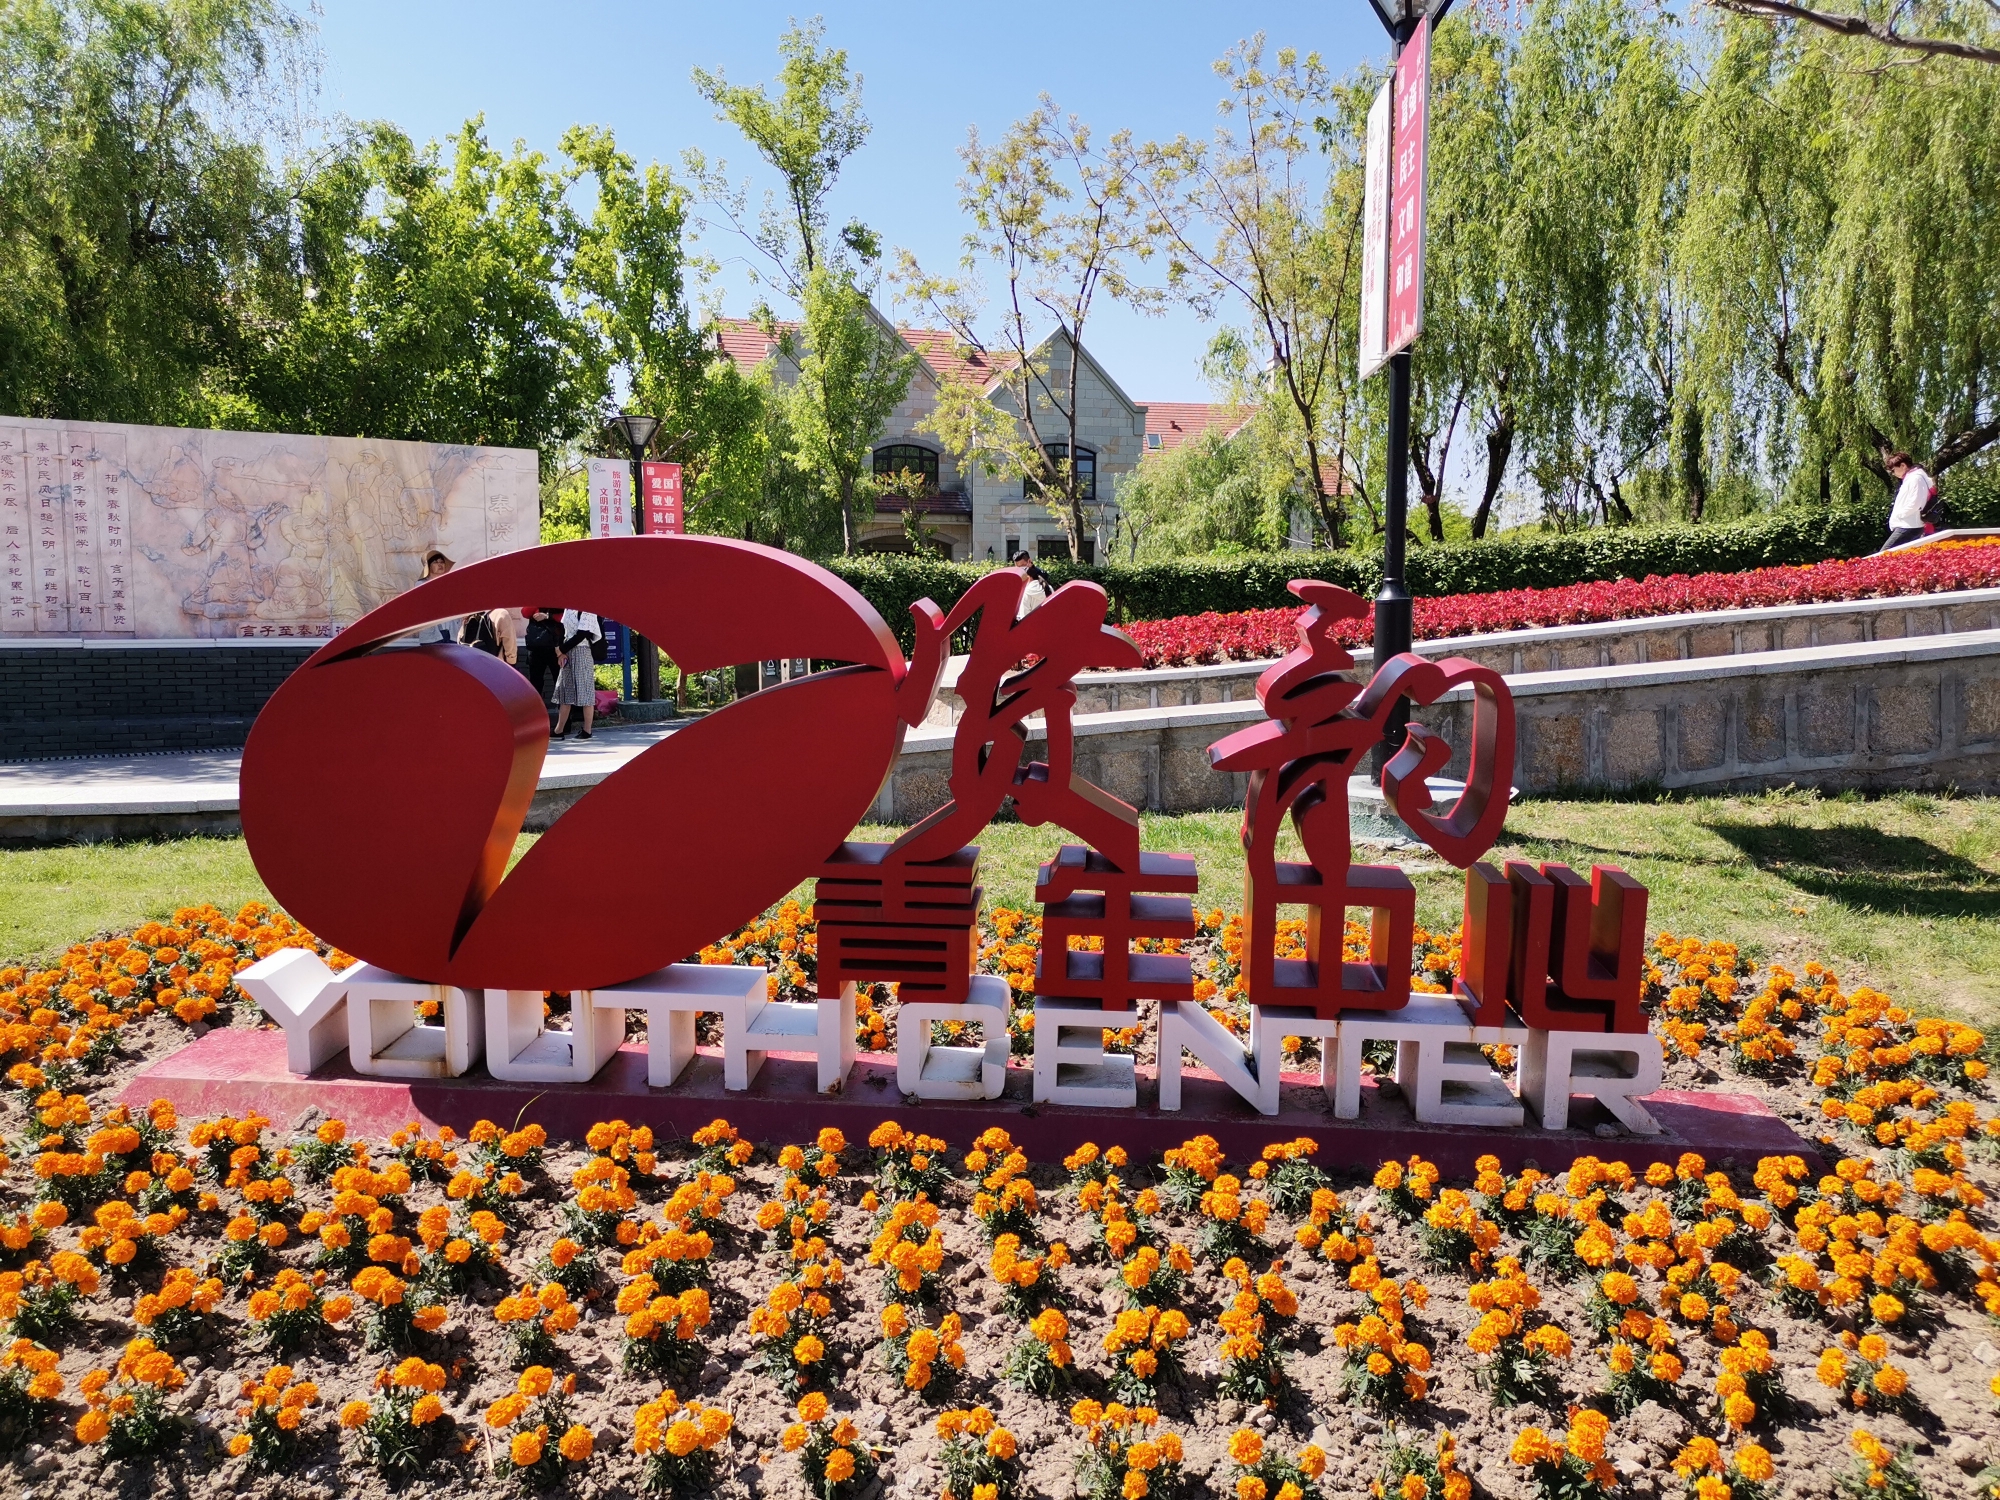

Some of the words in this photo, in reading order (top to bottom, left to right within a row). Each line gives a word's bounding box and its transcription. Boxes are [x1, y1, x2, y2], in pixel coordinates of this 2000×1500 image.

[1401, 78, 1418, 133] 富强
[1399, 141, 1416, 189] 民主
[1397, 195, 1414, 244] 文明
[1395, 253, 1413, 298] 和谐
[652, 478, 674, 489] 爱国
[652, 495, 674, 507] 敬业
[653, 512, 674, 523] 诚信
[233, 947, 857, 1093] YOUTH
[896, 973, 1663, 1134] CENTER
